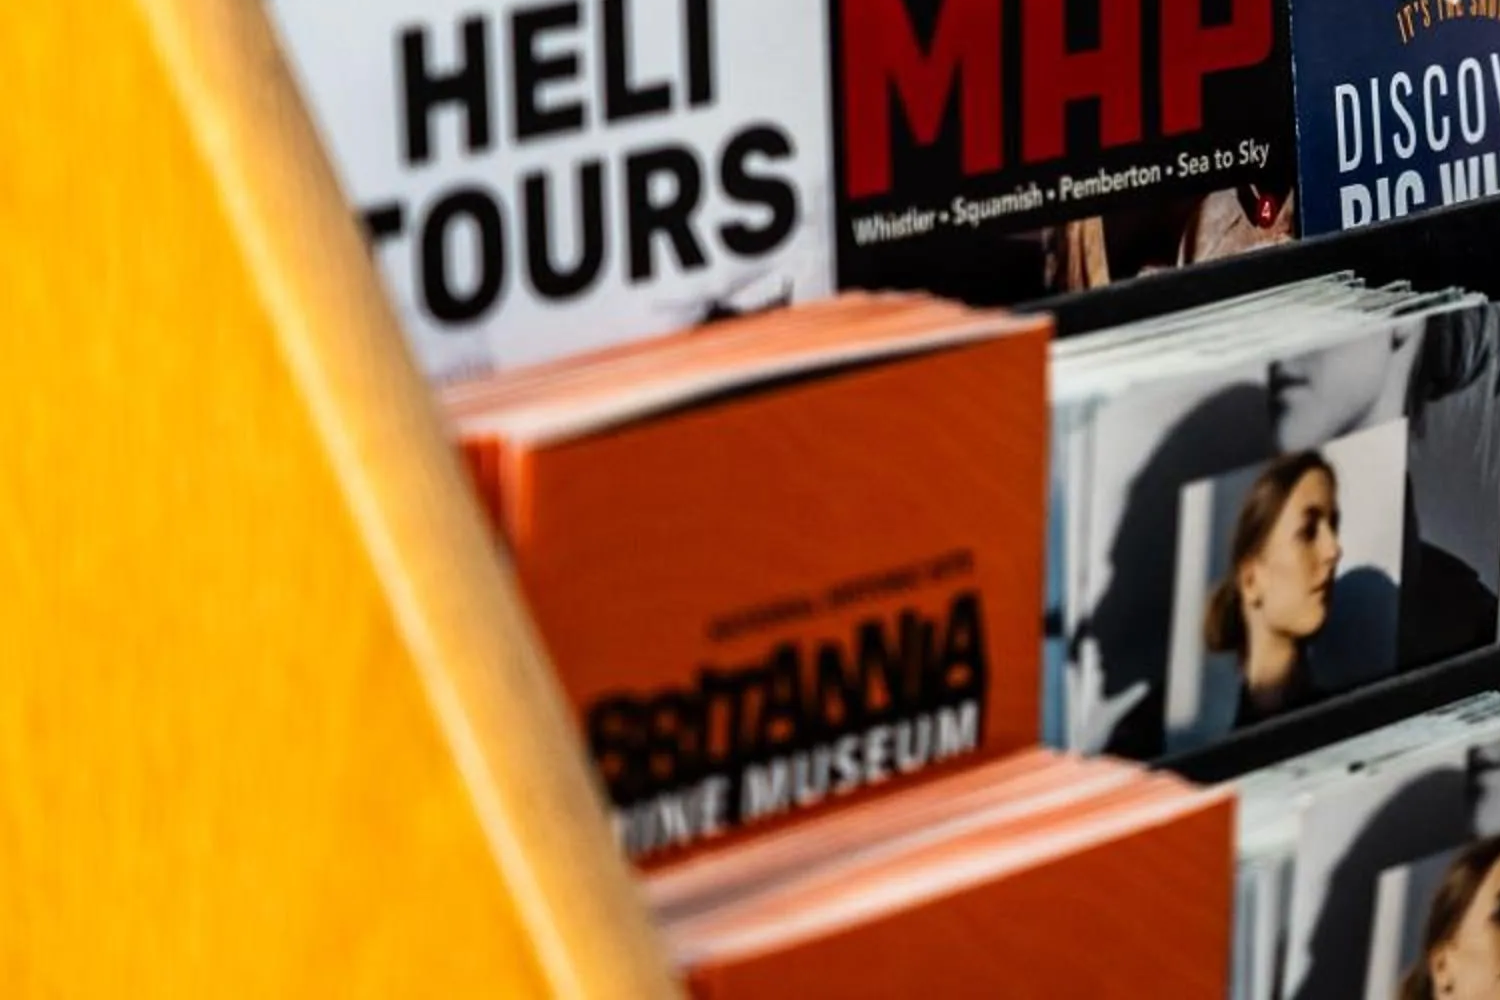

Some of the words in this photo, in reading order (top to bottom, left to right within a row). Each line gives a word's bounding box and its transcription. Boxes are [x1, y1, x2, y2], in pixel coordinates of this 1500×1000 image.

[852, 208, 936, 247] Whistler
[951, 183, 1044, 229] Squamish
[1059, 162, 1162, 202] Pemberton
[1177, 153, 1210, 179] Sea
[1214, 148, 1233, 168] to
[1238, 138, 1270, 167] Sky
[738, 699, 979, 825] MUSEUM
